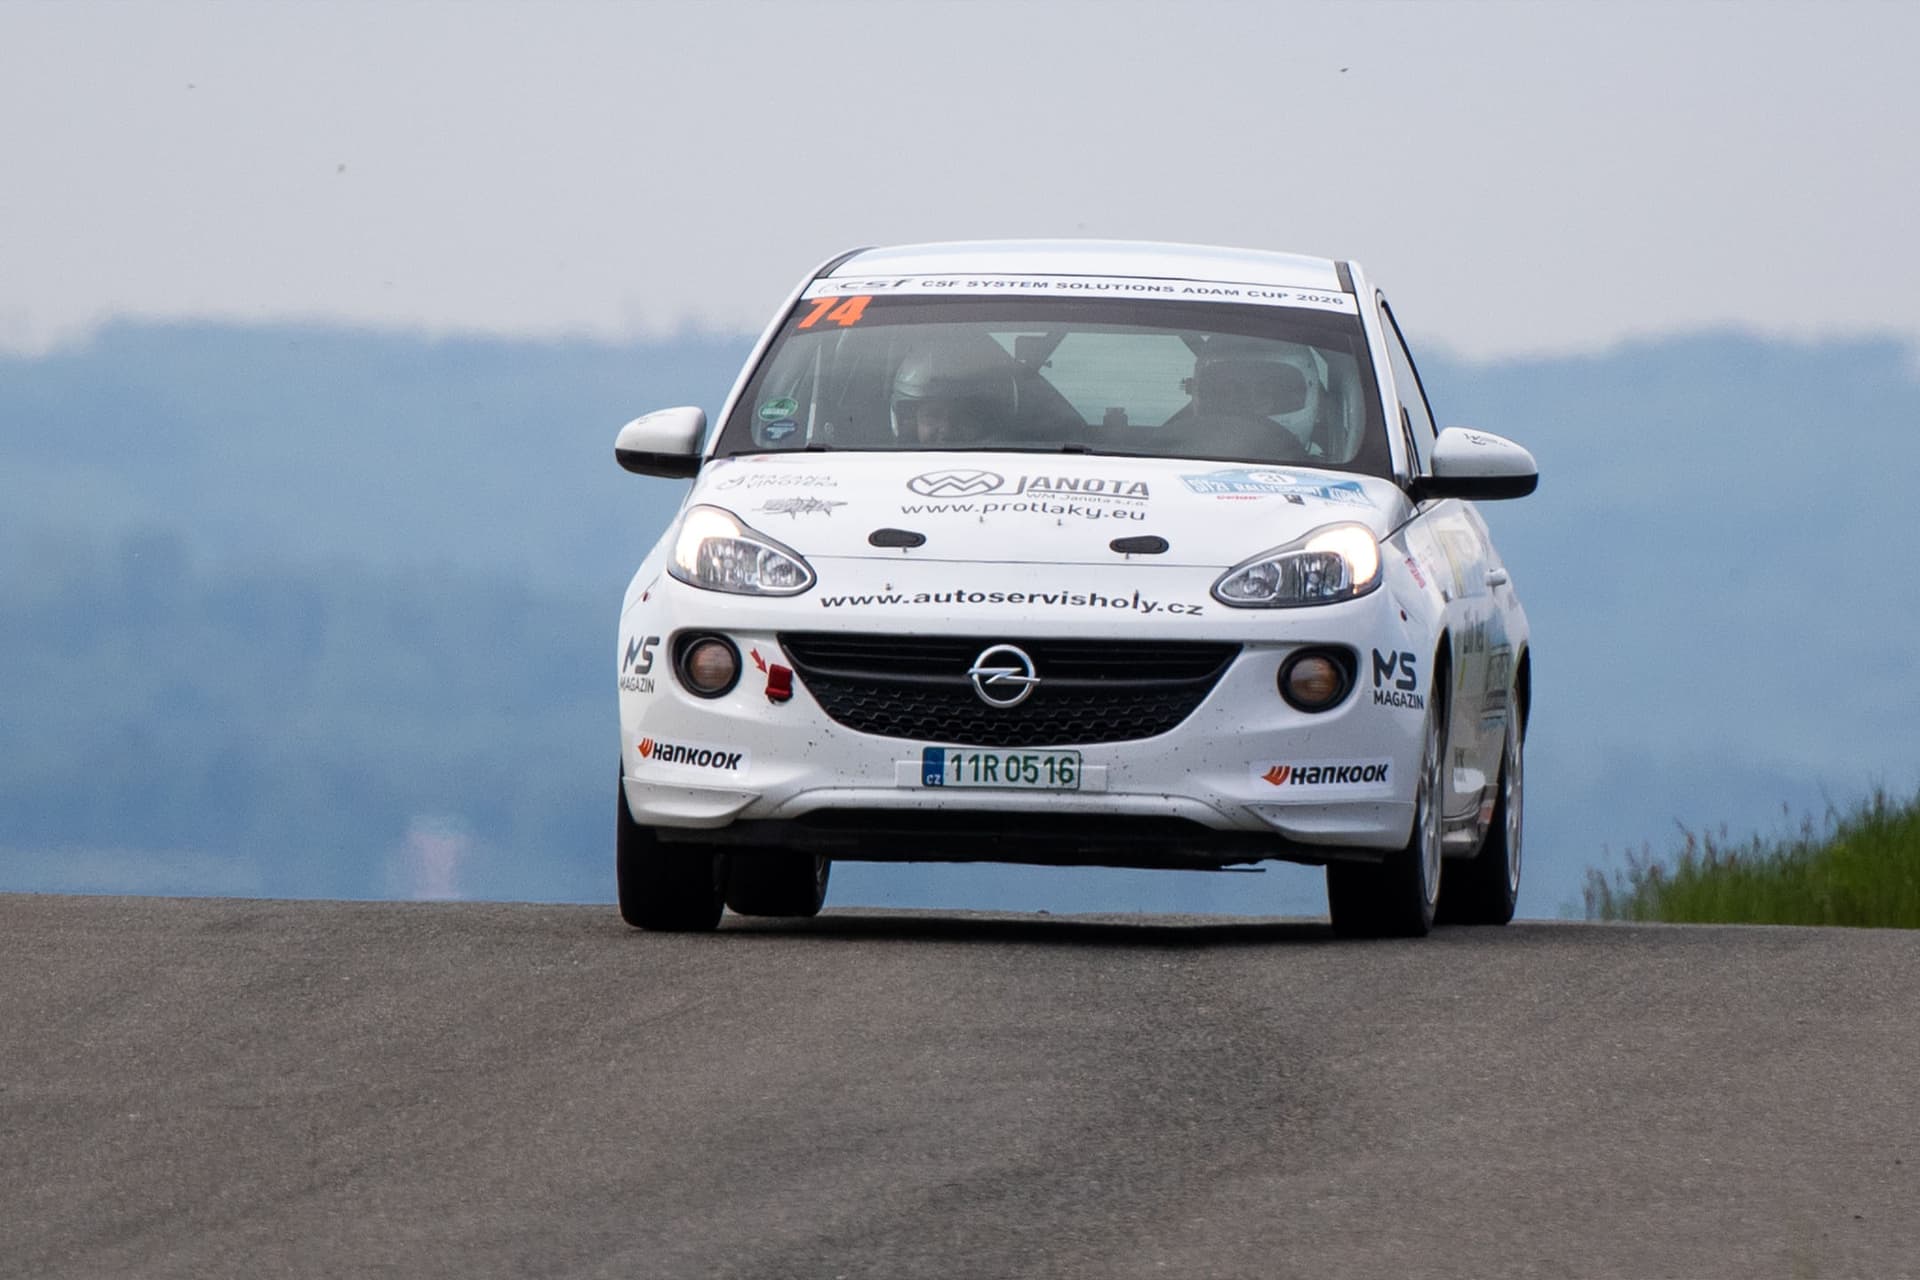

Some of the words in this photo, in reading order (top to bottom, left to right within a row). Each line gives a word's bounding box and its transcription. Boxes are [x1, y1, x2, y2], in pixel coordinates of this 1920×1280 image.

[922, 280, 960, 288] CSF
[967, 280, 1048, 289] SYSTEM
[1056, 282, 1175, 293] SOLUTIONS
[1182, 287, 1240, 296] ADAM
[1247, 290, 1288, 299] CUP
[1296, 294, 1344, 305] 2026
[798, 296, 873, 329] 74
[1017, 475, 1149, 497] JANOTA
[1059, 494, 1111, 504] Janota
[901, 502, 1146, 521] www.protlaky.eu
[820, 589, 1204, 616] www.autoservisholy.cz
[622, 635, 660, 675] MS
[1372, 648, 1416, 691] MS
[620, 677, 655, 694] MAGAZIN
[1373, 690, 1424, 710] MAGAZIN
[926, 775, 942, 786] CZ
[950, 754, 999, 783] 11R
[1005, 755, 1075, 784] 0516
